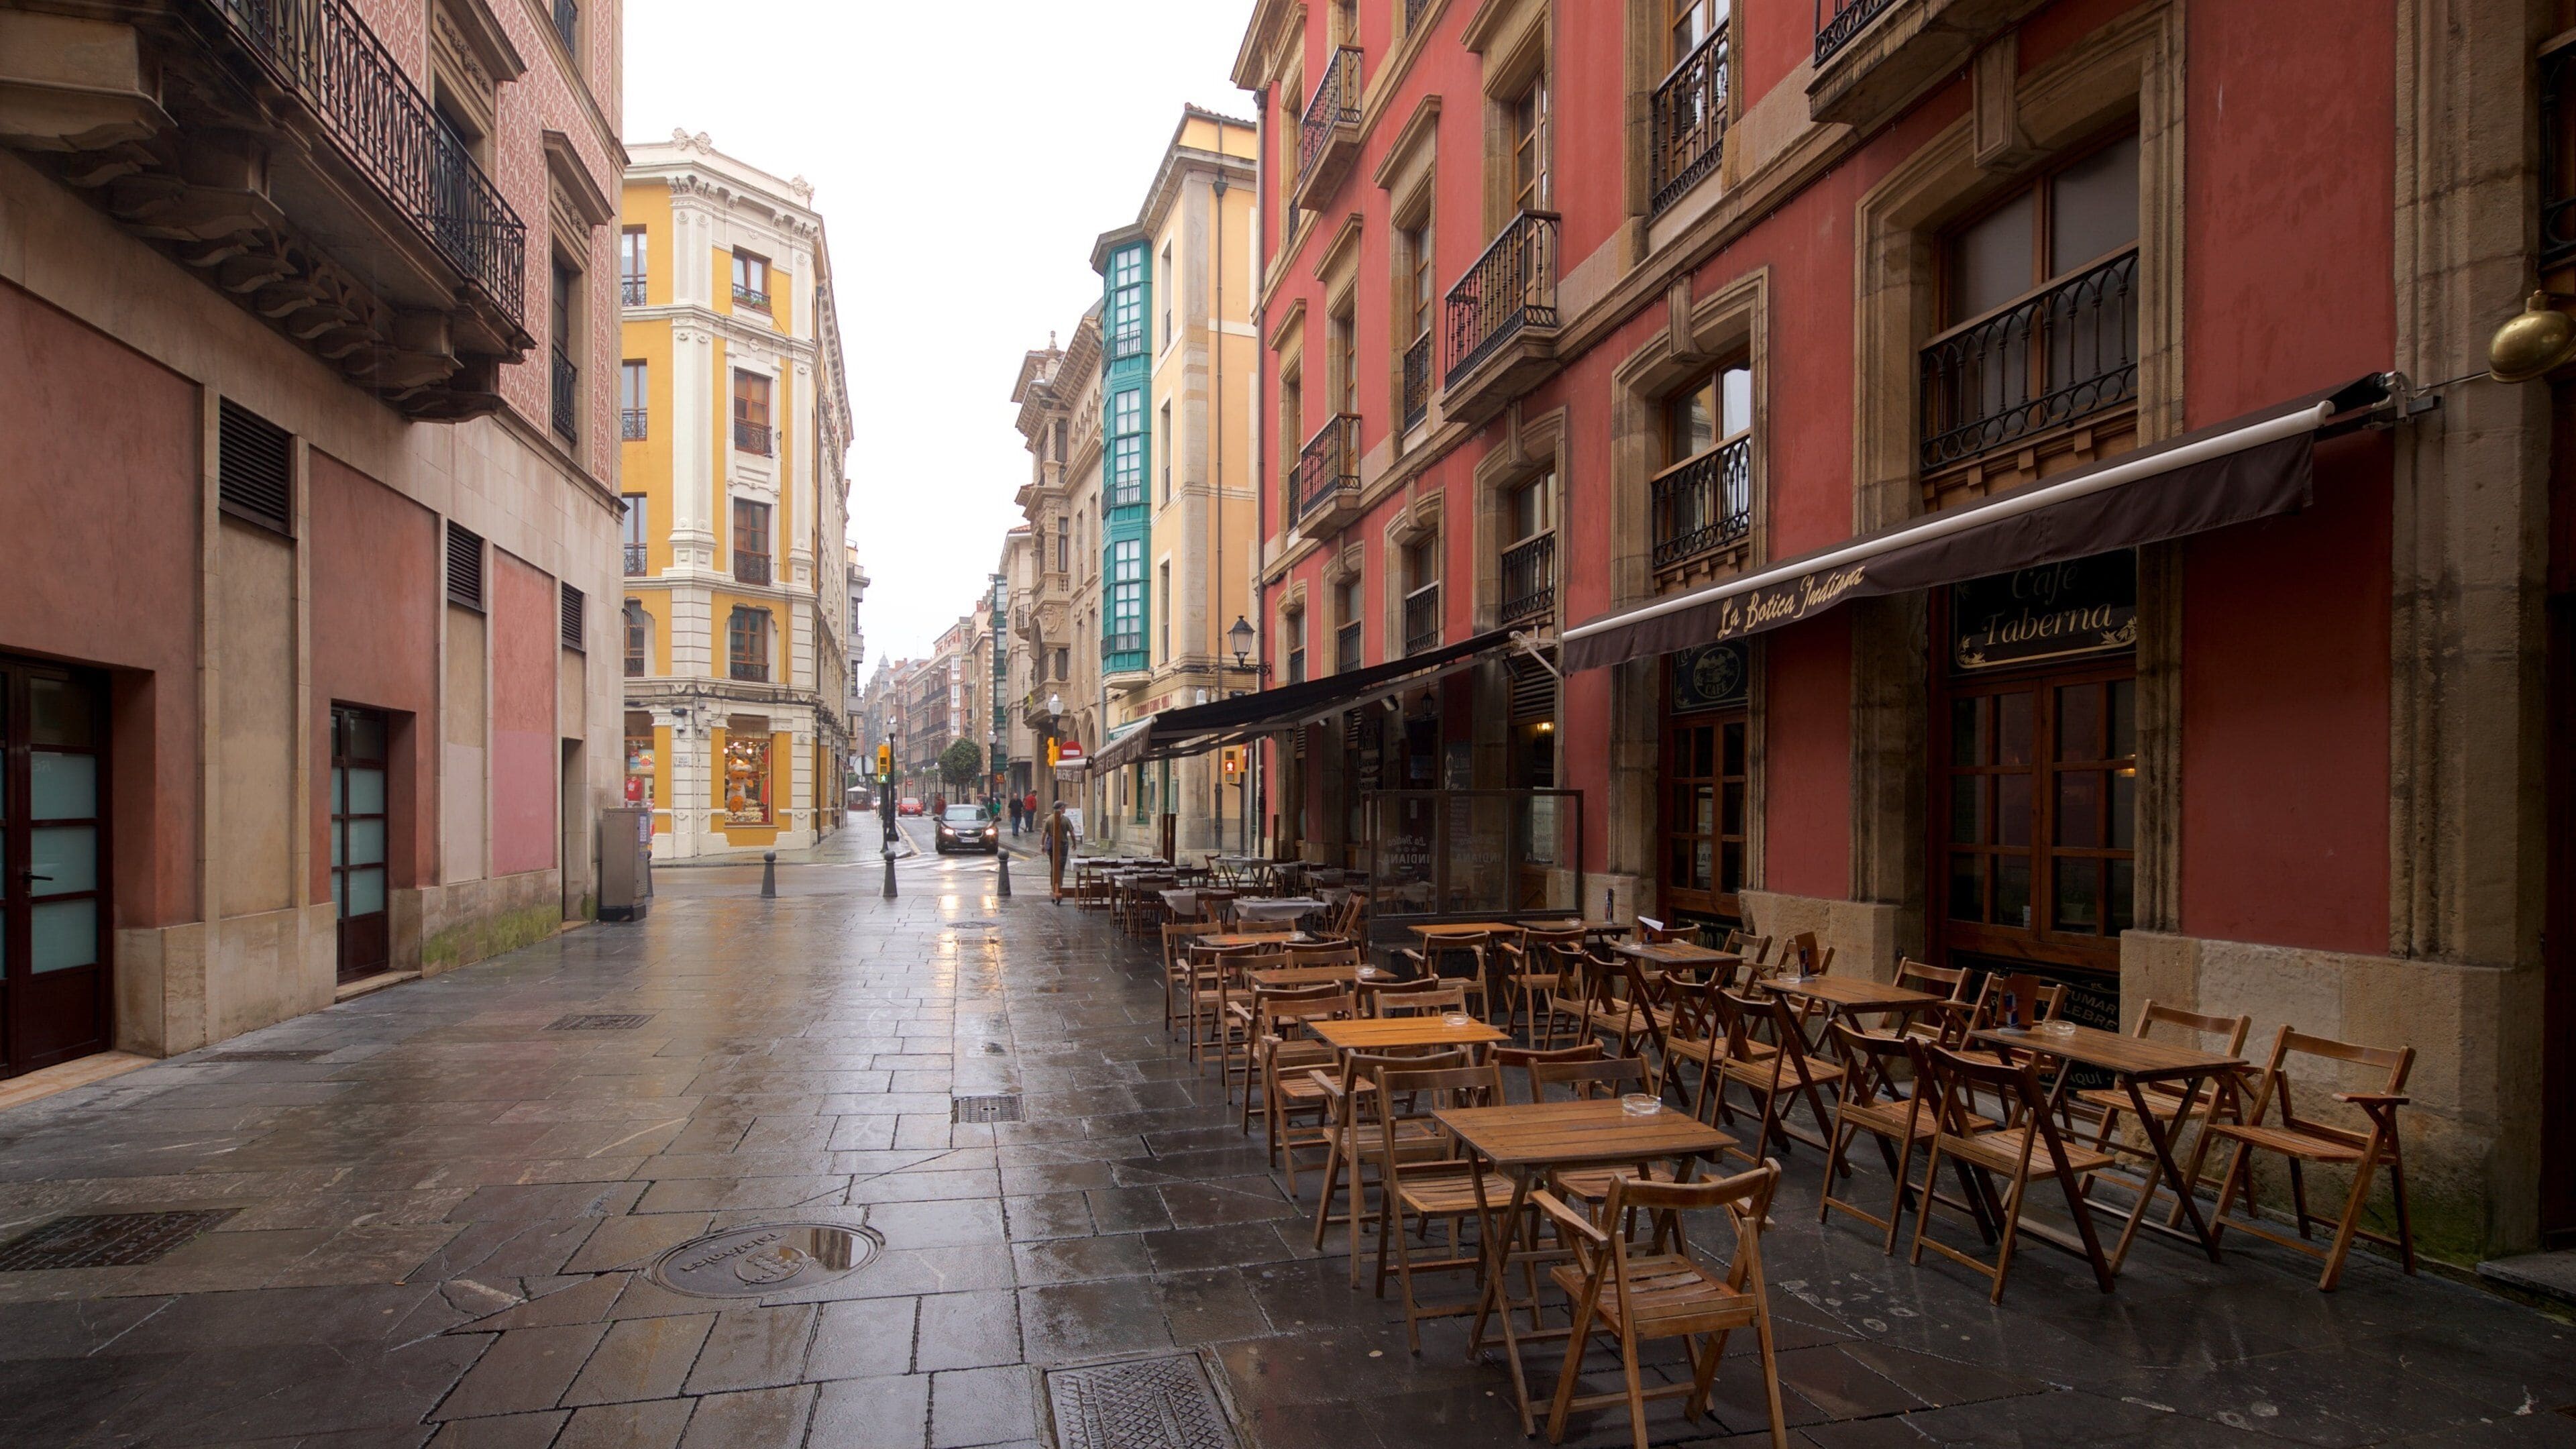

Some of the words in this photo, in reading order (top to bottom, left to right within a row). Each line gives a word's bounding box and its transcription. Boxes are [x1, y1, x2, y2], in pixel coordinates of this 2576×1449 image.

[1717, 598, 1739, 639] La
[1743, 591, 1795, 633] Botica
[1792, 566, 1866, 619] Indiana
[1981, 602, 2112, 647] Taberna
